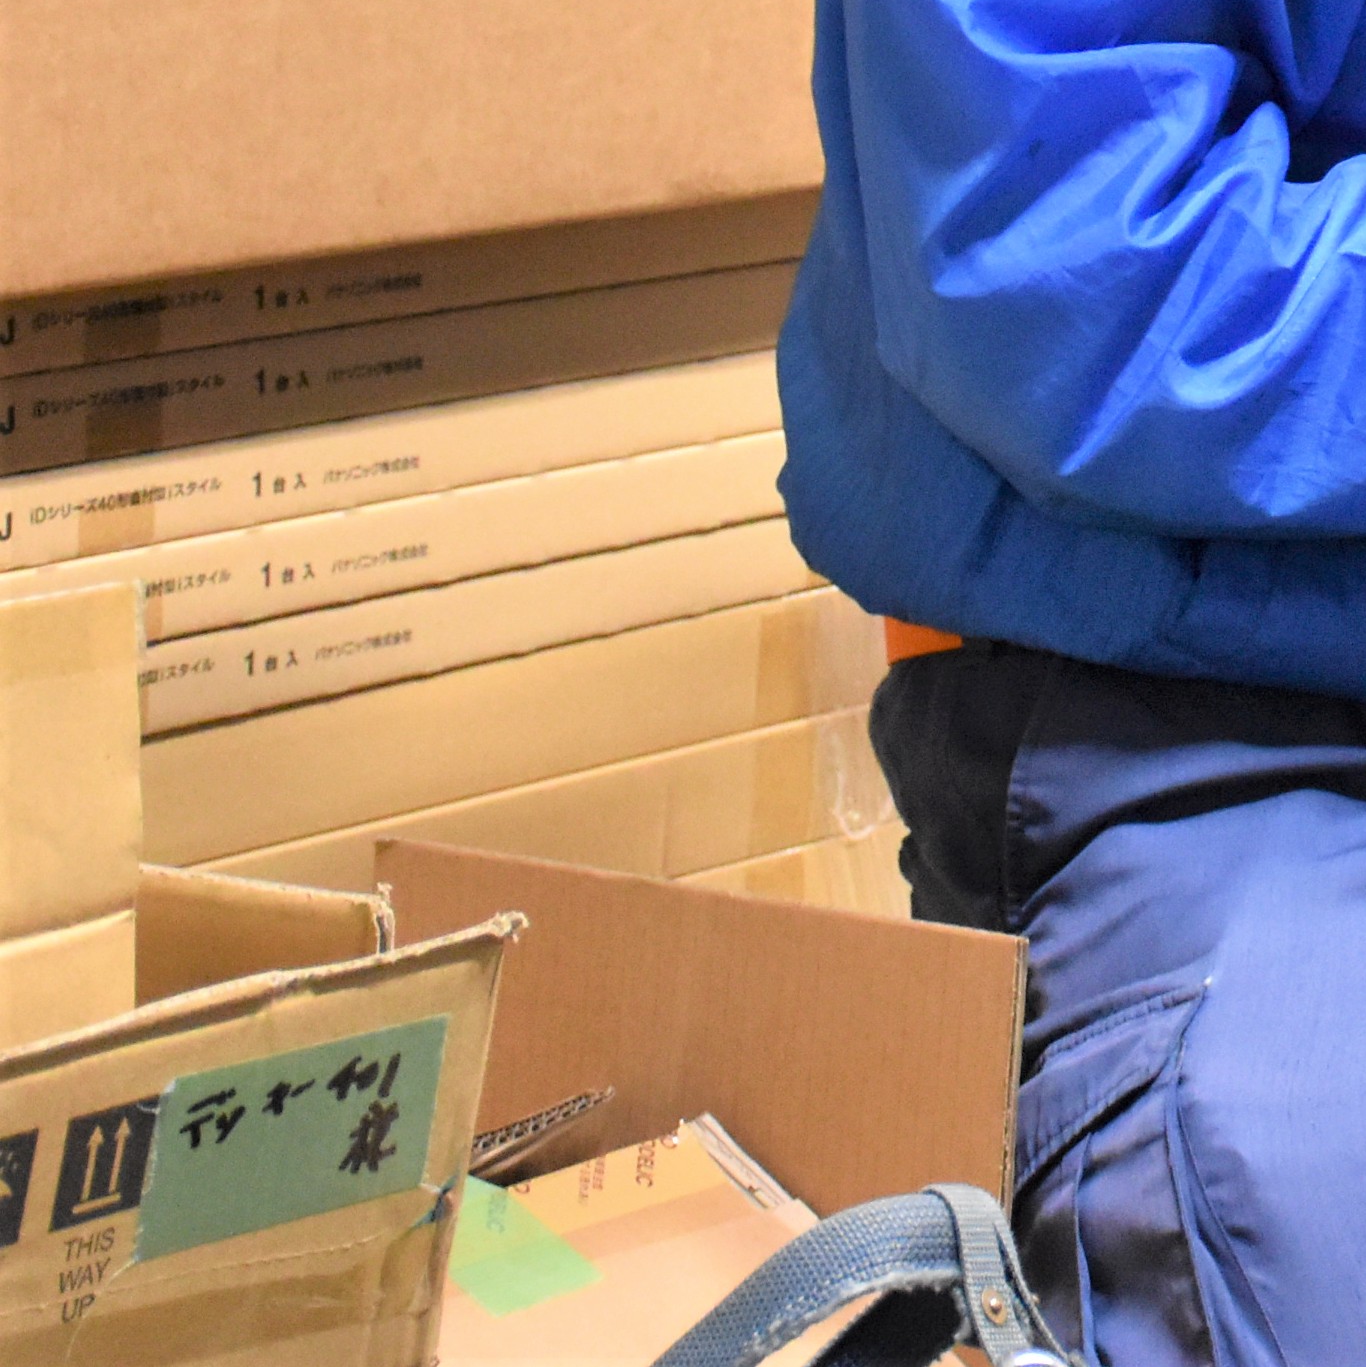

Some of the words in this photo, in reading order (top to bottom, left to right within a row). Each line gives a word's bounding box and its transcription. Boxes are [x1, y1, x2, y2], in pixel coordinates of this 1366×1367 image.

[63, 1226, 117, 1263] THIS
[58, 1257, 113, 1295] WAY
[60, 1293, 97, 1324] UP
